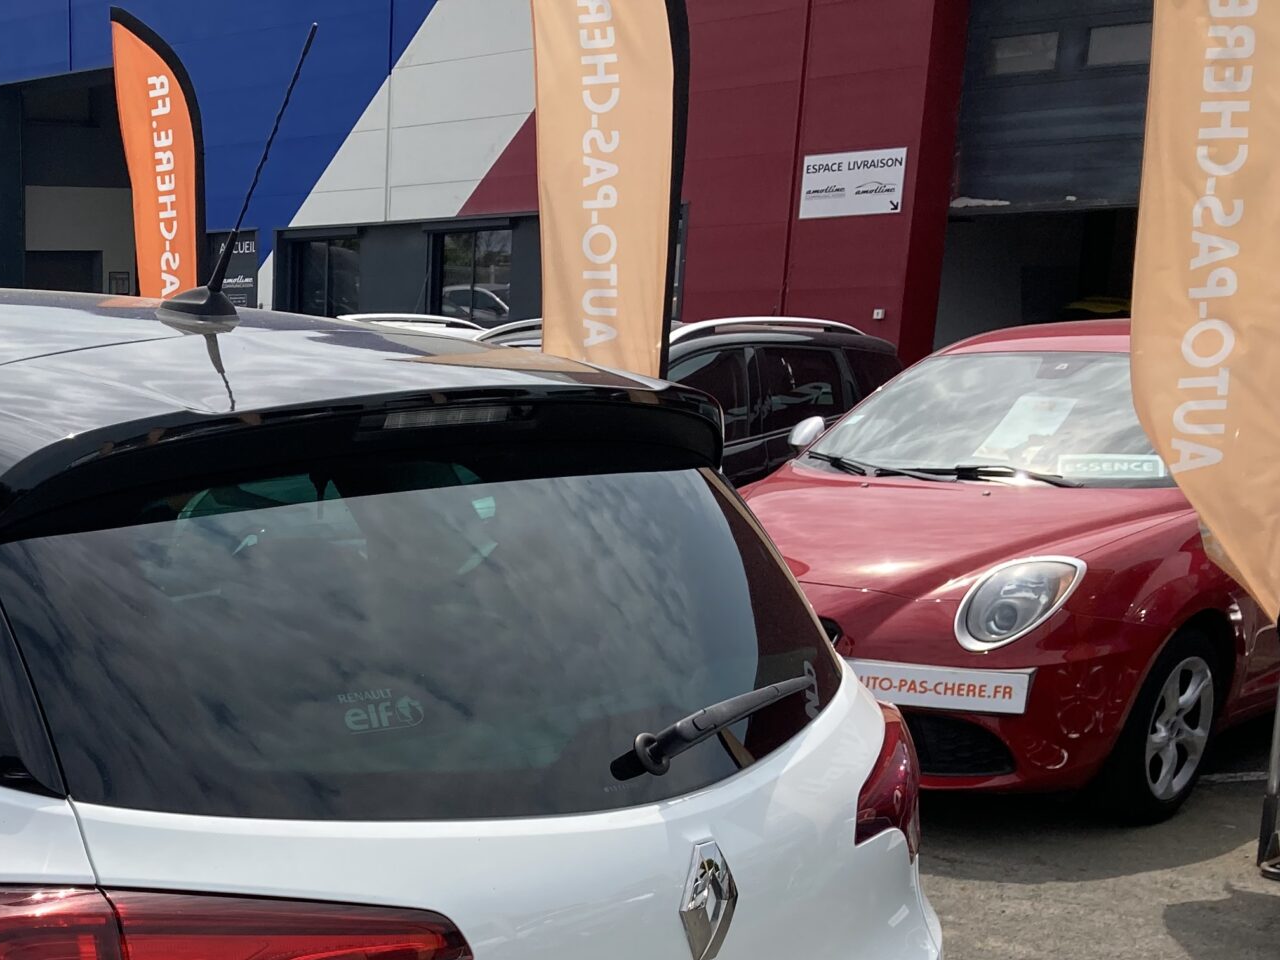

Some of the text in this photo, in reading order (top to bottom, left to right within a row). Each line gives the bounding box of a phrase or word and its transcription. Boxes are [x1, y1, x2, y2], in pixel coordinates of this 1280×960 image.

[806, 157, 903, 174] ESPACE LIVRAISON
[219, 241, 257, 254] ACUEIL
[1064, 461, 1154, 473] ESSENCE
[337, 688, 393, 703] RENAULT
[344, 701, 394, 731] elf
